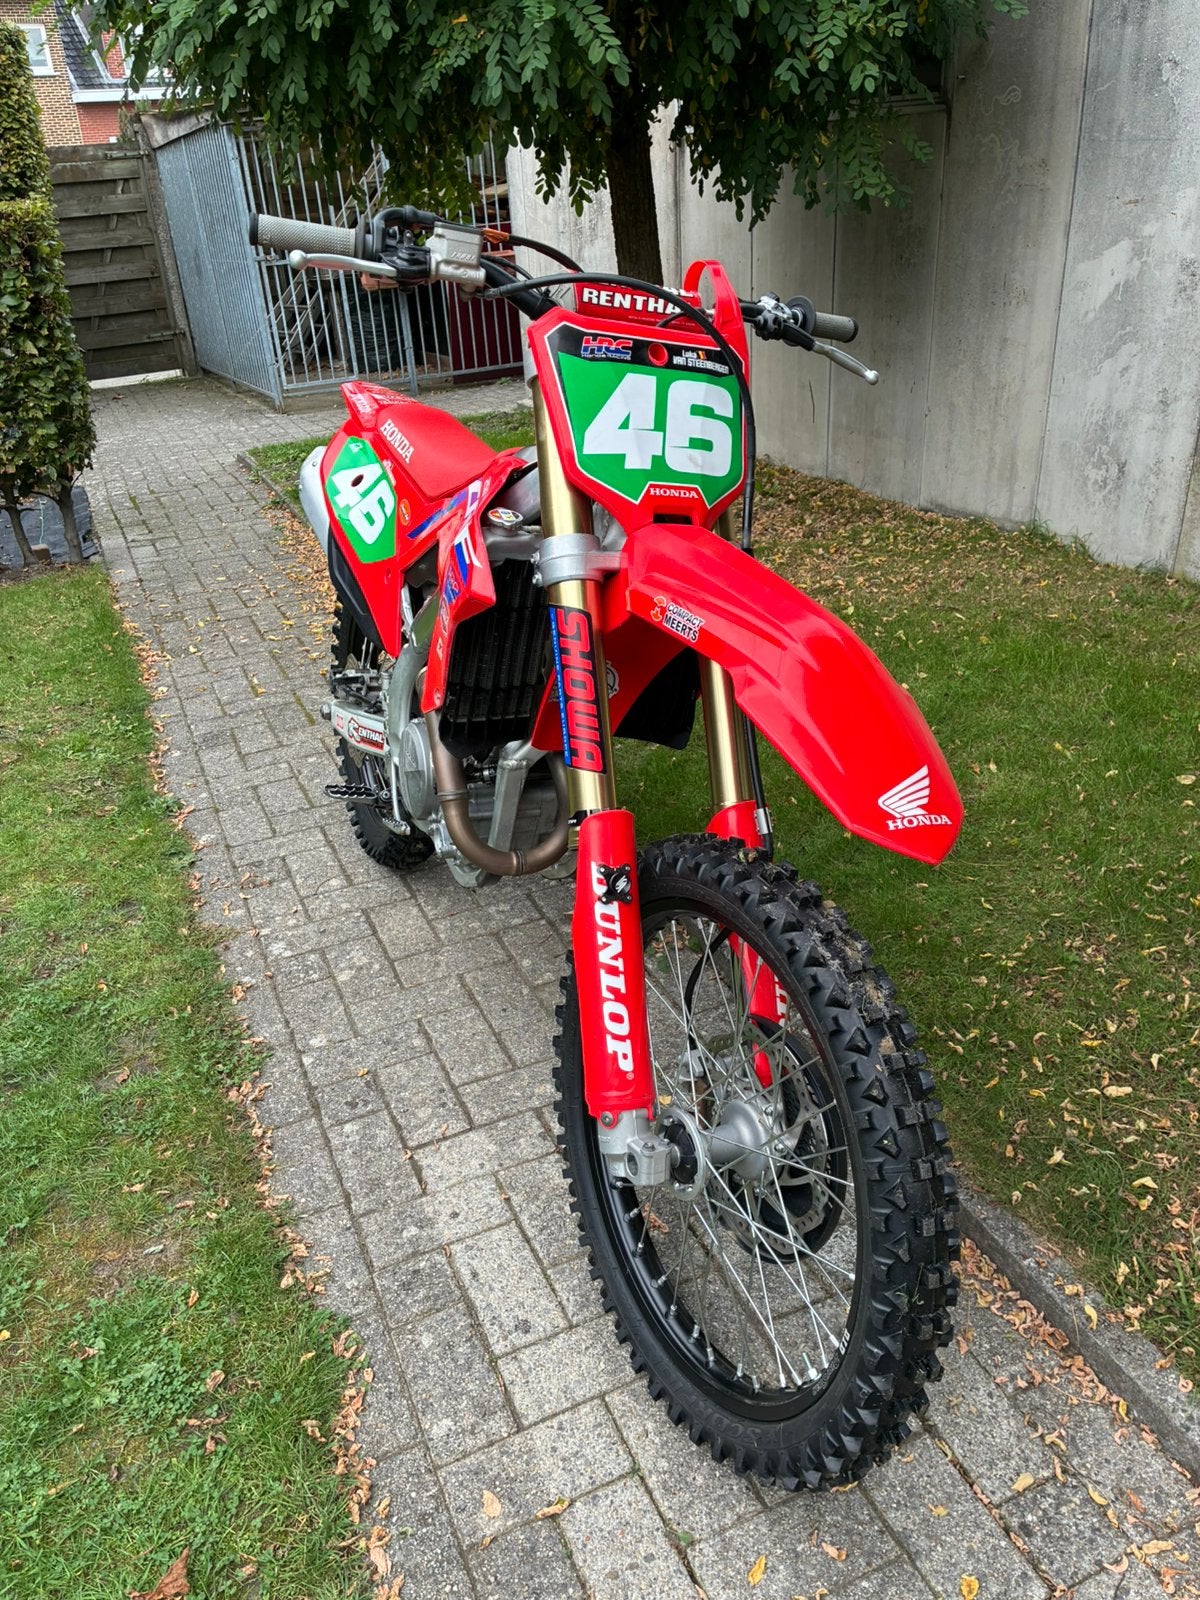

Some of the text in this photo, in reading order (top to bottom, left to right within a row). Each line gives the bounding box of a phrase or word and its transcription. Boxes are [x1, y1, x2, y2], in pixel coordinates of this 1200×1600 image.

[581, 336, 633, 355] HRC
[672, 356, 686, 366] VAN
[583, 372, 734, 477] 46
[380, 418, 415, 464] HONDA
[331, 462, 396, 545] 46
[649, 486, 699, 499] HONDA
[663, 613, 698, 642] MEERTS
[667, 602, 704, 629] COMPACT
[556, 608, 604, 772] SHOWA
[885, 814, 953, 831] HONDA
[591, 861, 635, 1079] DUNLOP
